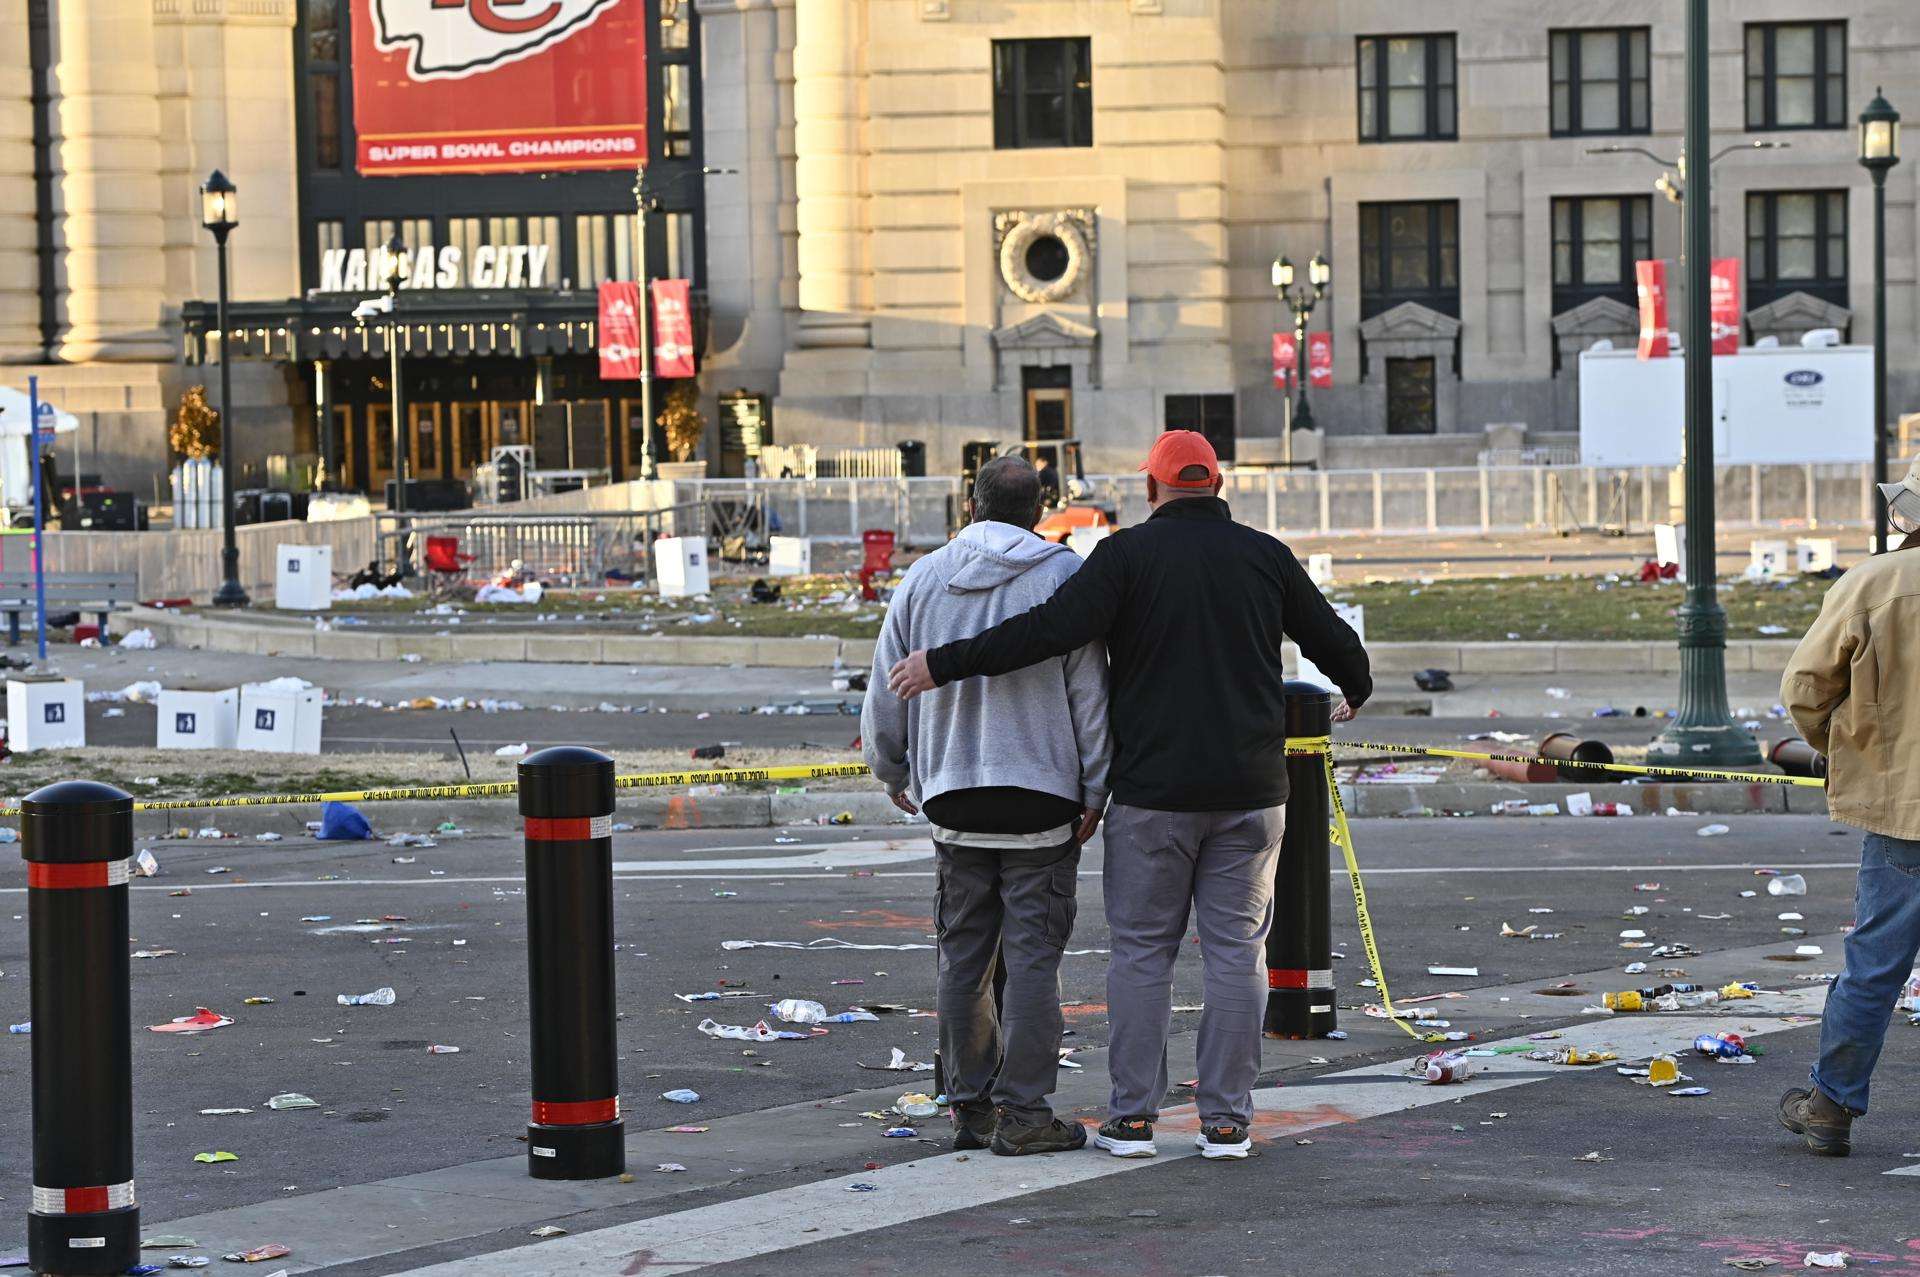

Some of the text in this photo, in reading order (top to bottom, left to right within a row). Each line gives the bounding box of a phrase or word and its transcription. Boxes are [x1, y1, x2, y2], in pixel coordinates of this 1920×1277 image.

[368, 137, 636, 161] SUPER BOWL CHAMPIONS
[471, 245, 549, 288] CITY
